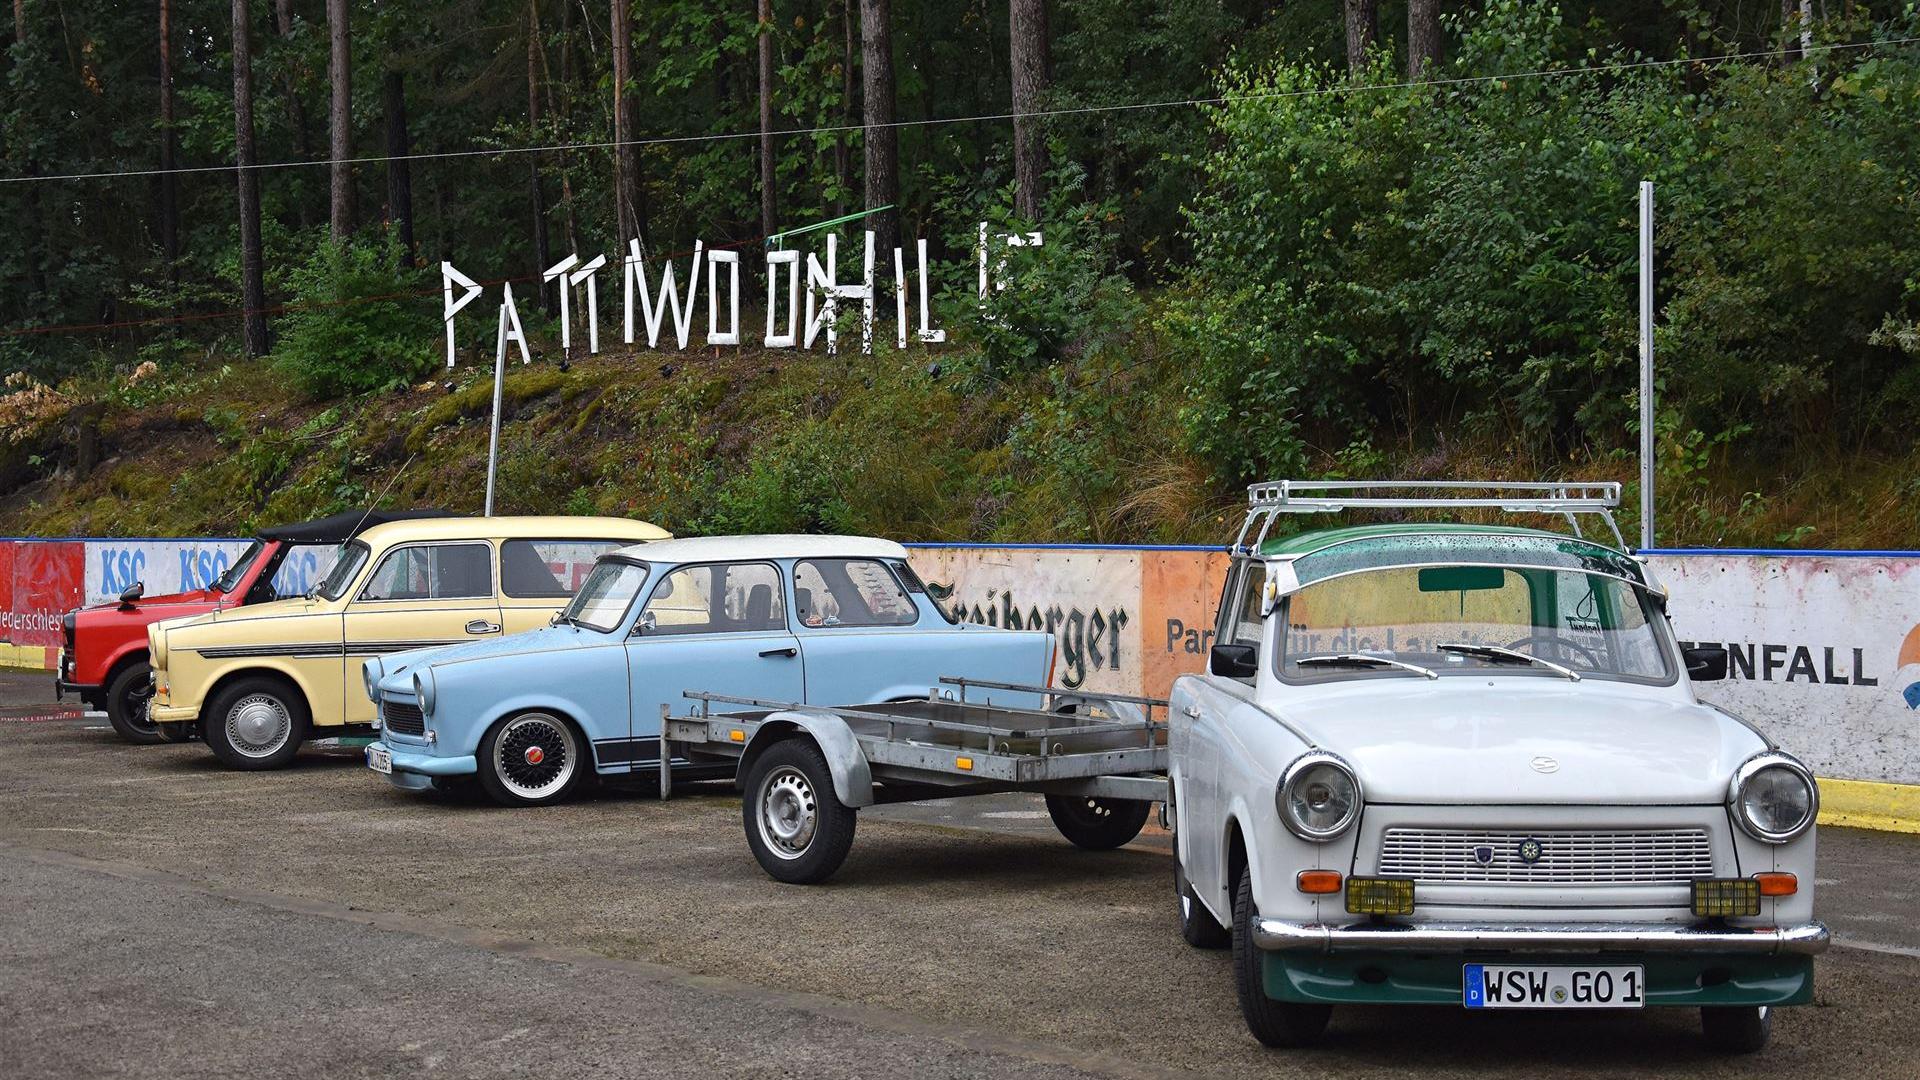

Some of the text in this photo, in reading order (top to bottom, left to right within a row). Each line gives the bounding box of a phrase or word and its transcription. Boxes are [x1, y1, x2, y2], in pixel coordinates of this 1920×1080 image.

[101, 551, 146, 595] KSC
[179, 550, 228, 593] KSC
[1167, 618, 1215, 654] Par
[1289, 624, 1322, 652] ür
[1332, 626, 1373, 653] die
[1470, 971, 1641, 1003] D WSW GO 1
